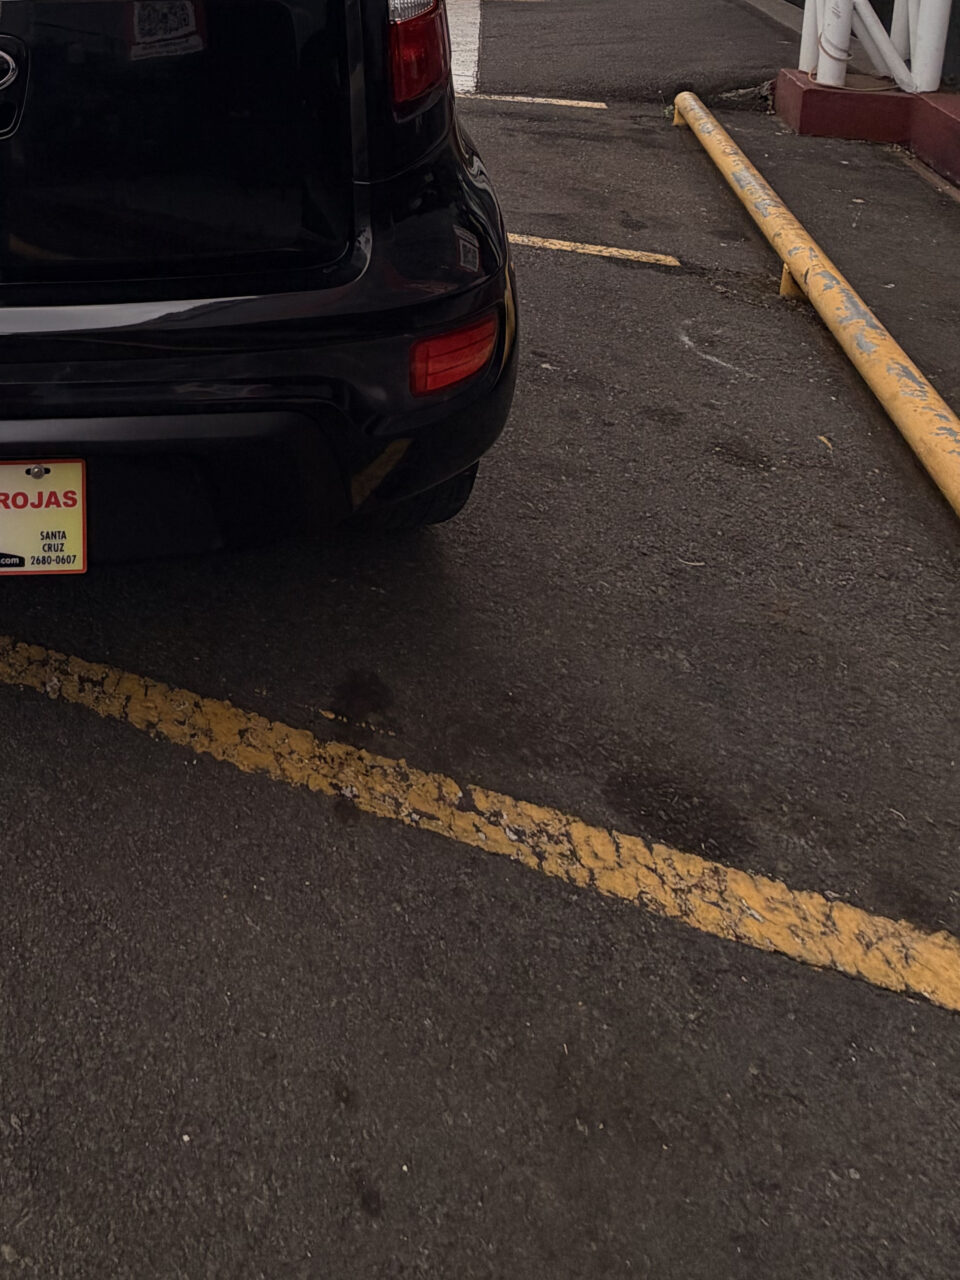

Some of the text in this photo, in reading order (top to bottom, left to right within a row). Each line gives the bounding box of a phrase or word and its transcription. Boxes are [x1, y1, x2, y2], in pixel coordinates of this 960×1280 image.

[40, 531, 67, 541] SANTA
[42, 543, 65, 553] CRUZ
[30, 555, 77, 566] 2680-0607
